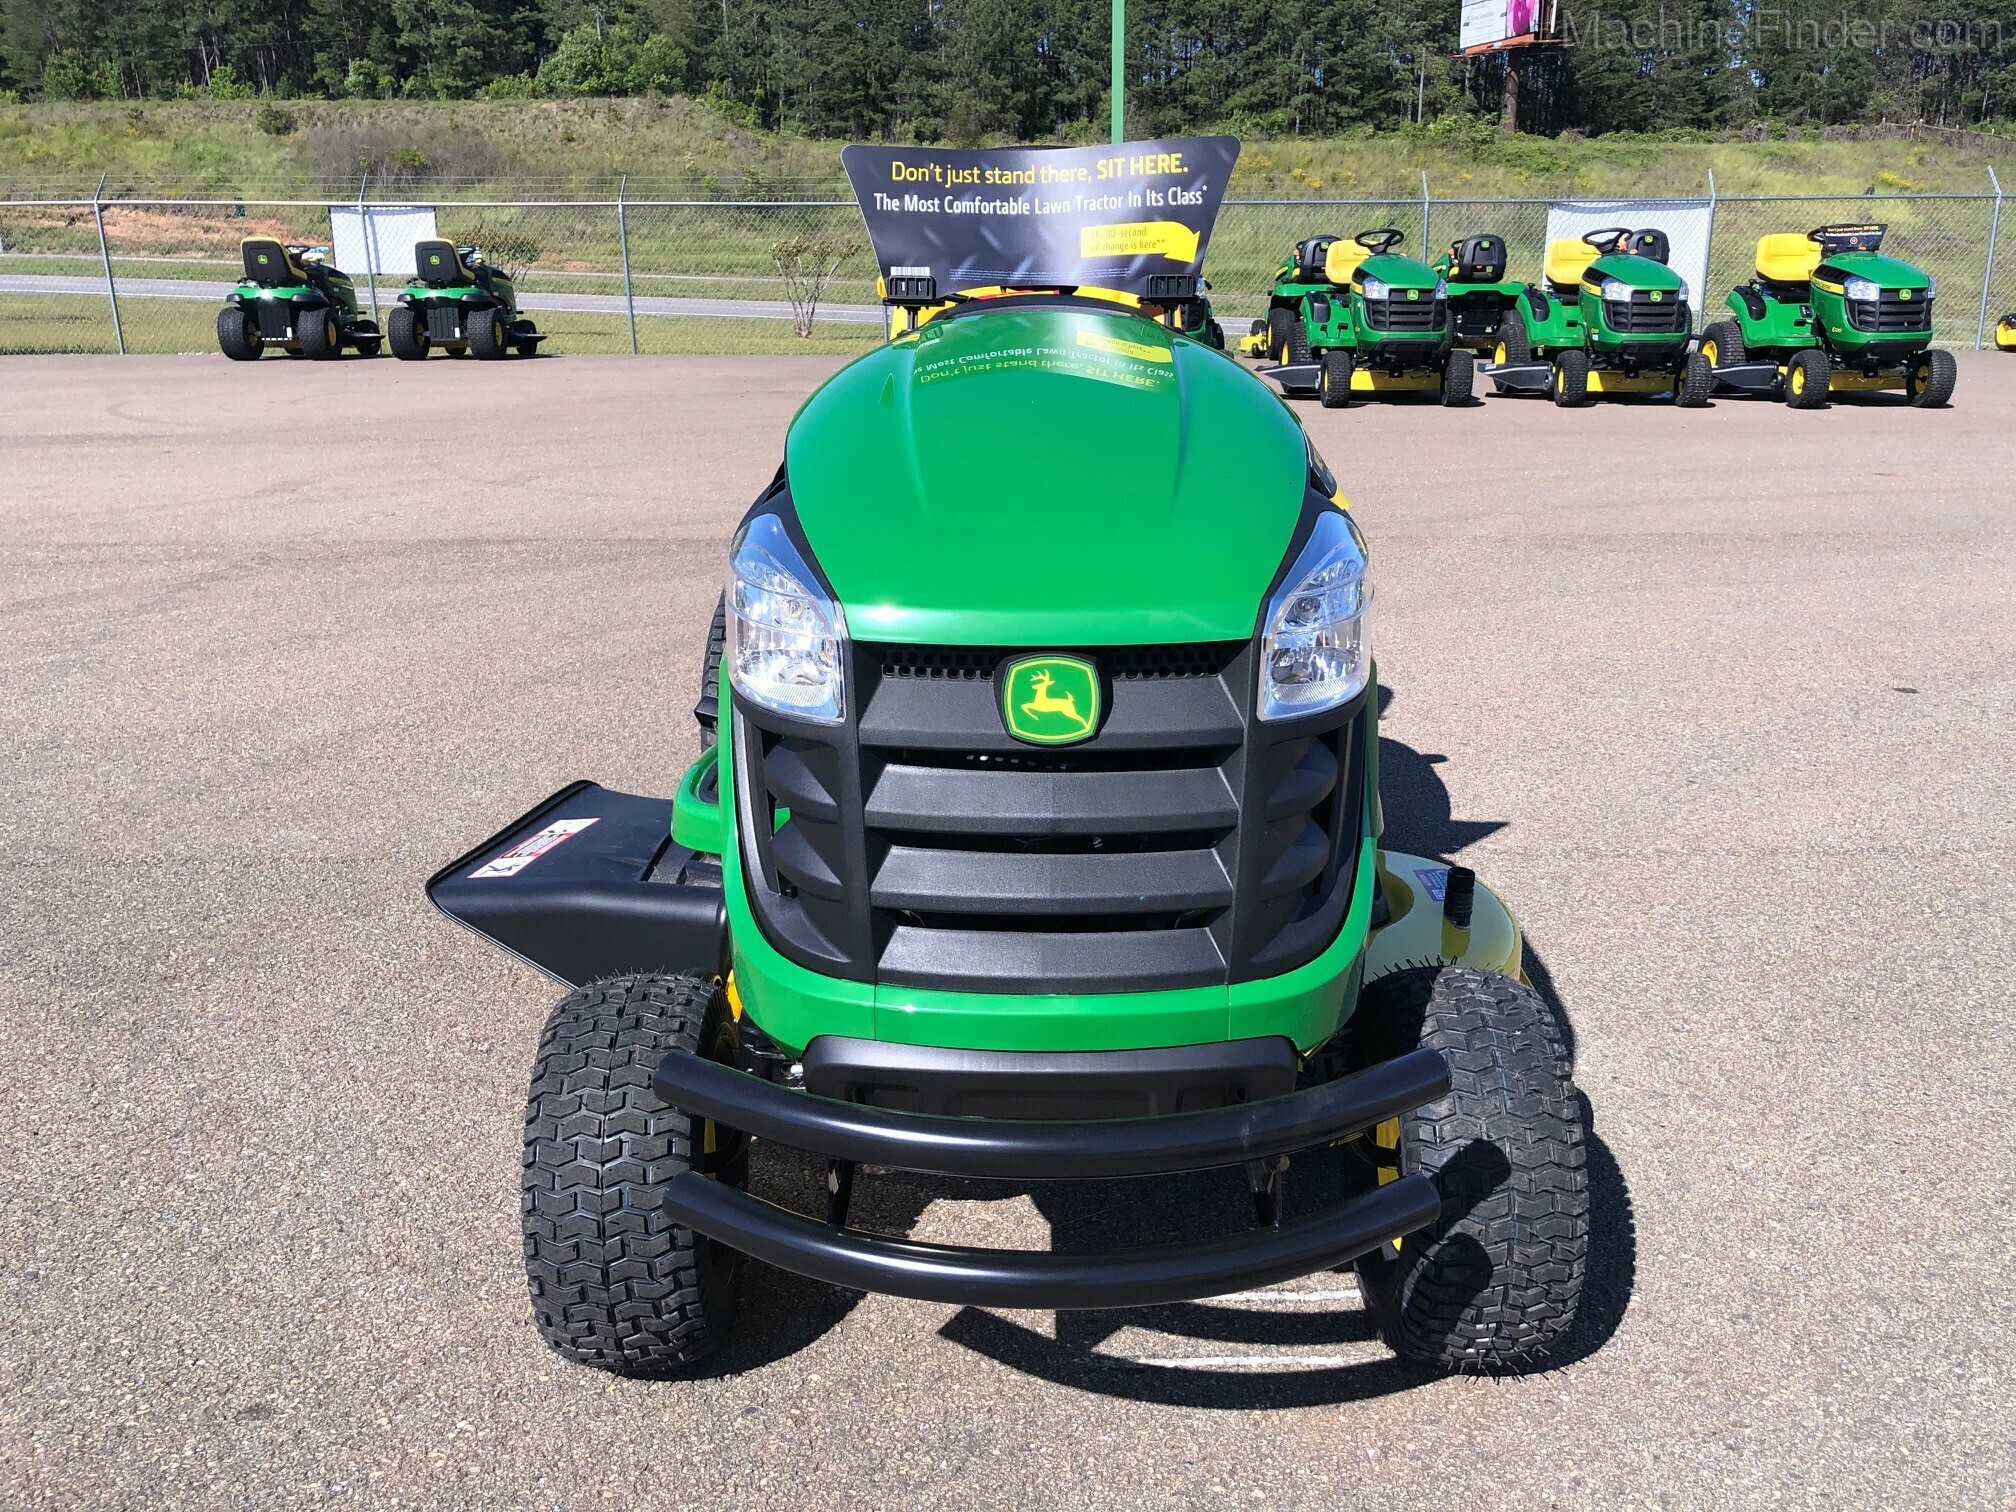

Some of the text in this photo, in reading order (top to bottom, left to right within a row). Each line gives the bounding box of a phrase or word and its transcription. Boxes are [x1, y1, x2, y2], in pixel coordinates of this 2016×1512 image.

[891, 152, 1189, 189] Don't just stand there, SIT HERE.
[873, 192, 900, 212] The
[904, 194, 940, 213] Most
[944, 195, 1030, 216] Comfortable
[1034, 197, 1071, 215] Lawn
[1074, 194, 1124, 213] Tractor
[1128, 190, 1142, 208] In
[1146, 188, 1164, 207] Its
[1106, 226, 1147, 239] 30-second
[1102, 241, 1129, 253] change
[1130, 240, 1138, 250] is
